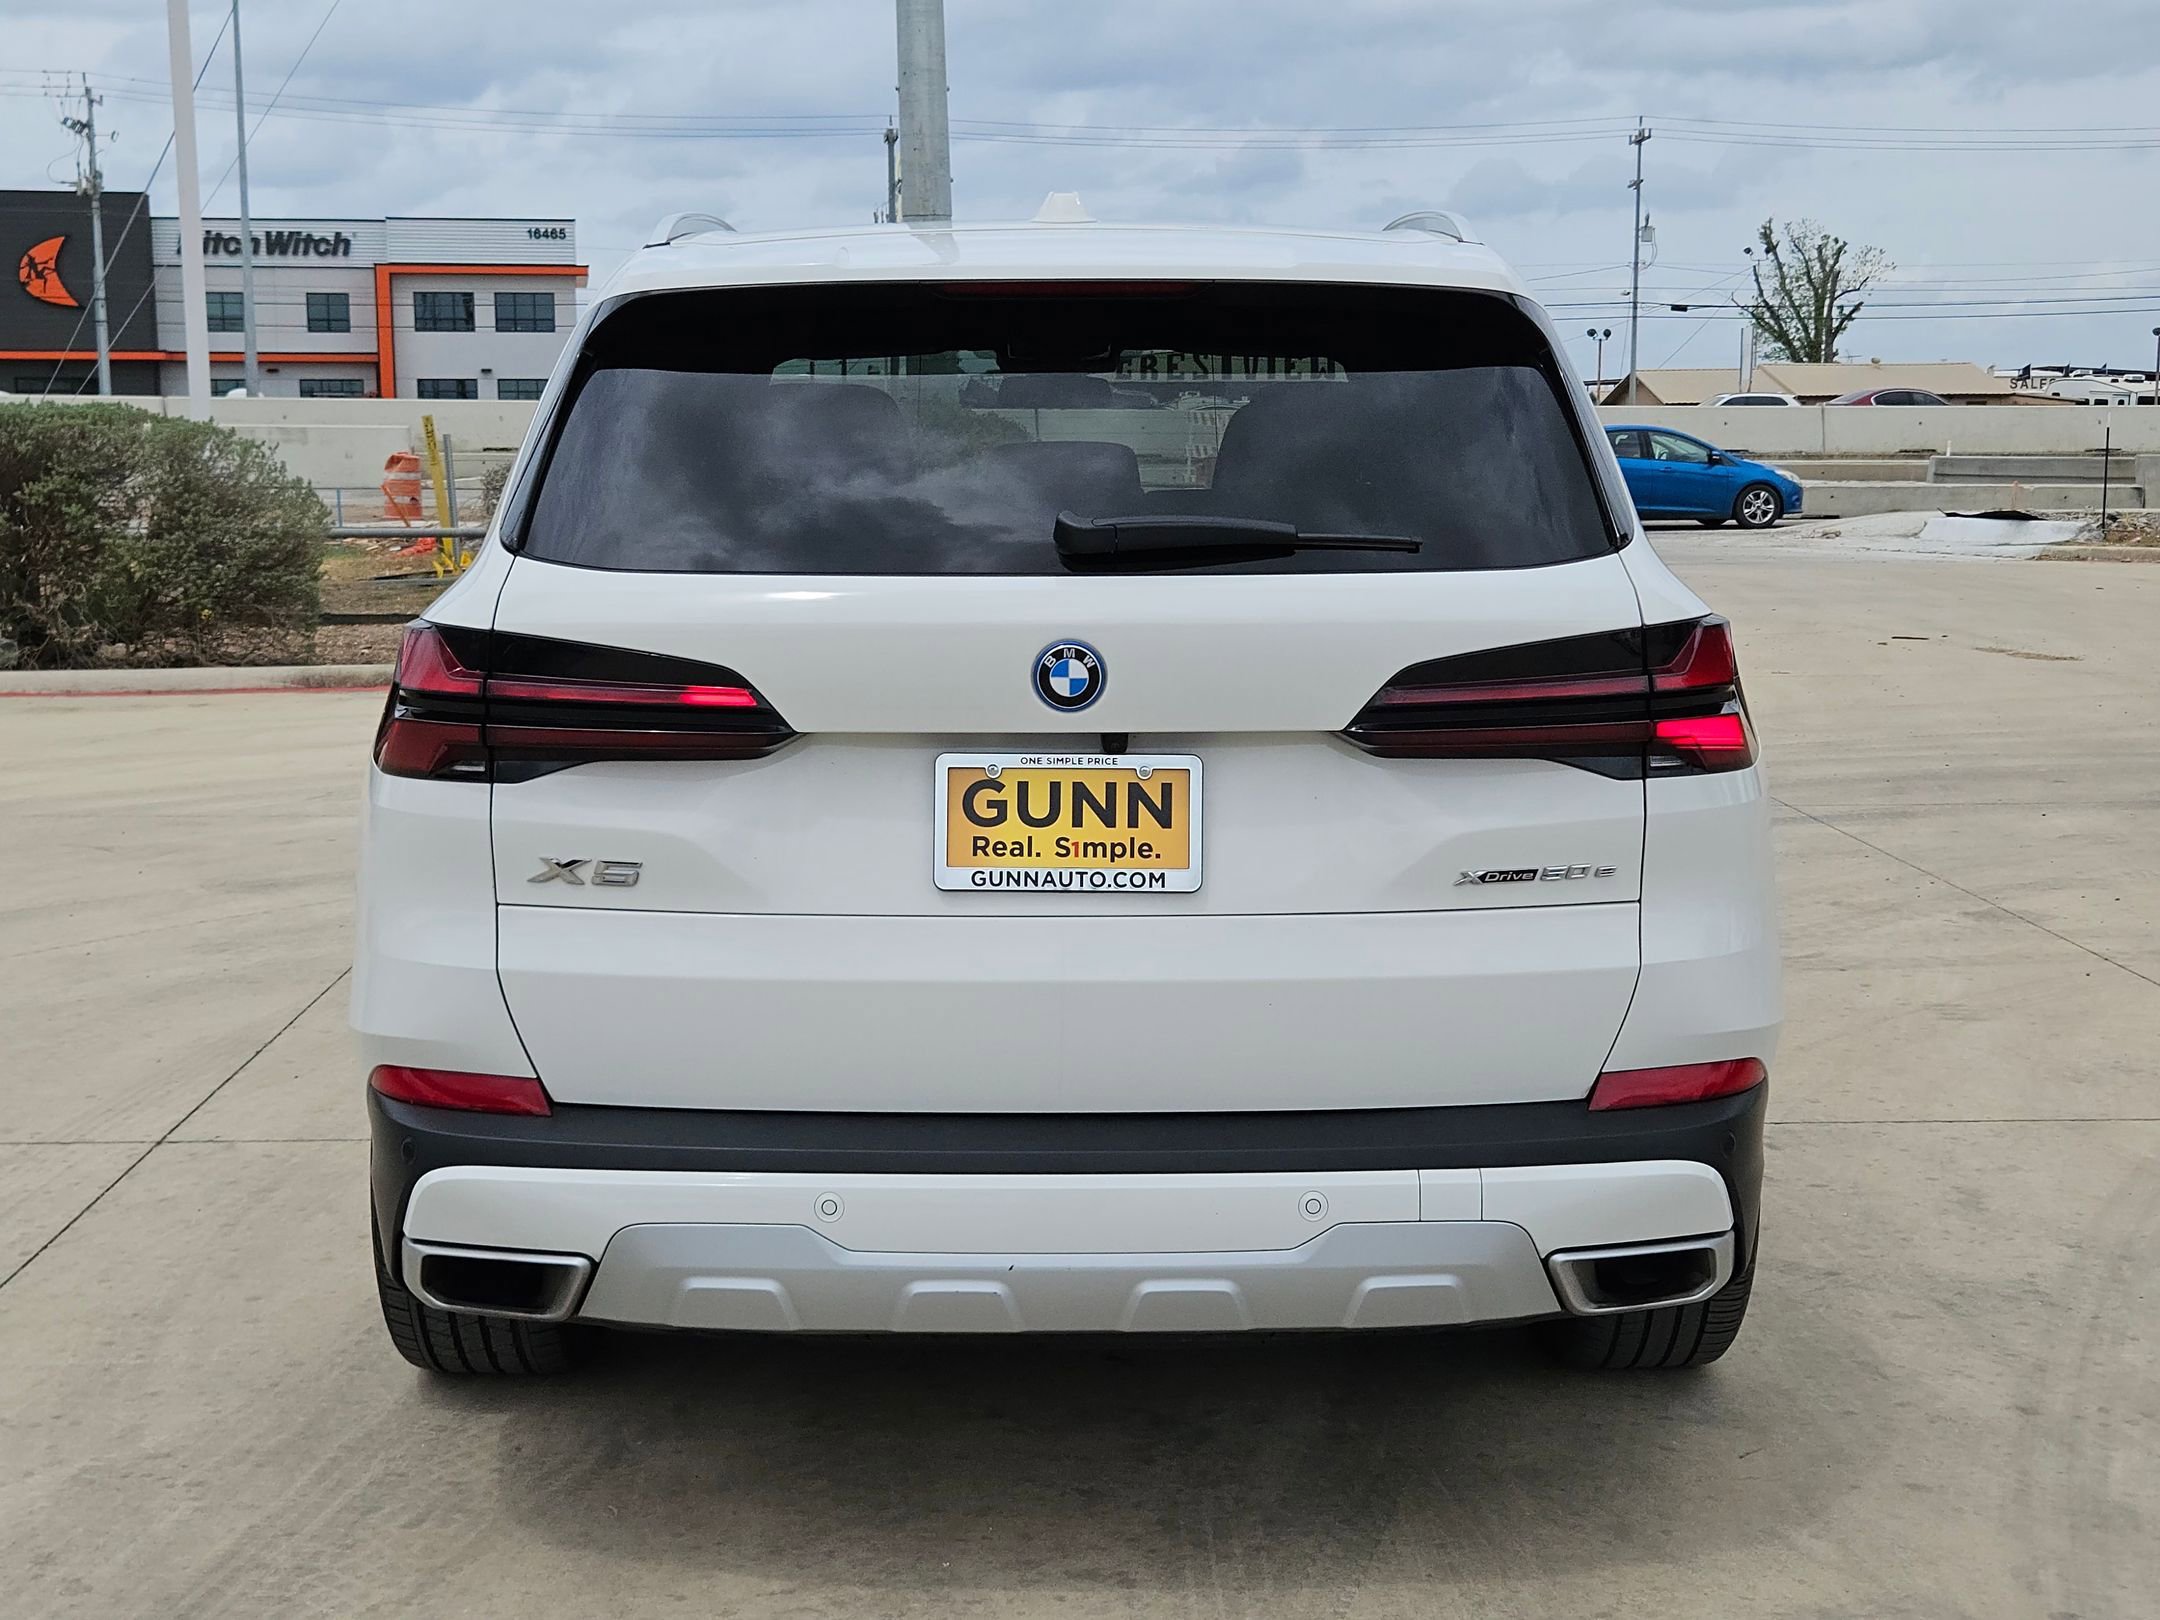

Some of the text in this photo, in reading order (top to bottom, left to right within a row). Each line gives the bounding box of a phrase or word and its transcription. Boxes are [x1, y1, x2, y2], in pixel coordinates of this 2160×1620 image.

[177, 230, 352, 257] itch Witch
[527, 228, 566, 240] 16465
[2009, 378, 2056, 390] SALE
[1043, 648, 1097, 669] BMW
[1020, 756, 1119, 766] ONE SIMPLE PRICE
[962, 778, 1174, 830] GUNN
[972, 835, 1041, 858] Real.
[526, 857, 644, 887] X5
[970, 870, 1167, 889] GUNNAUTO.COM
